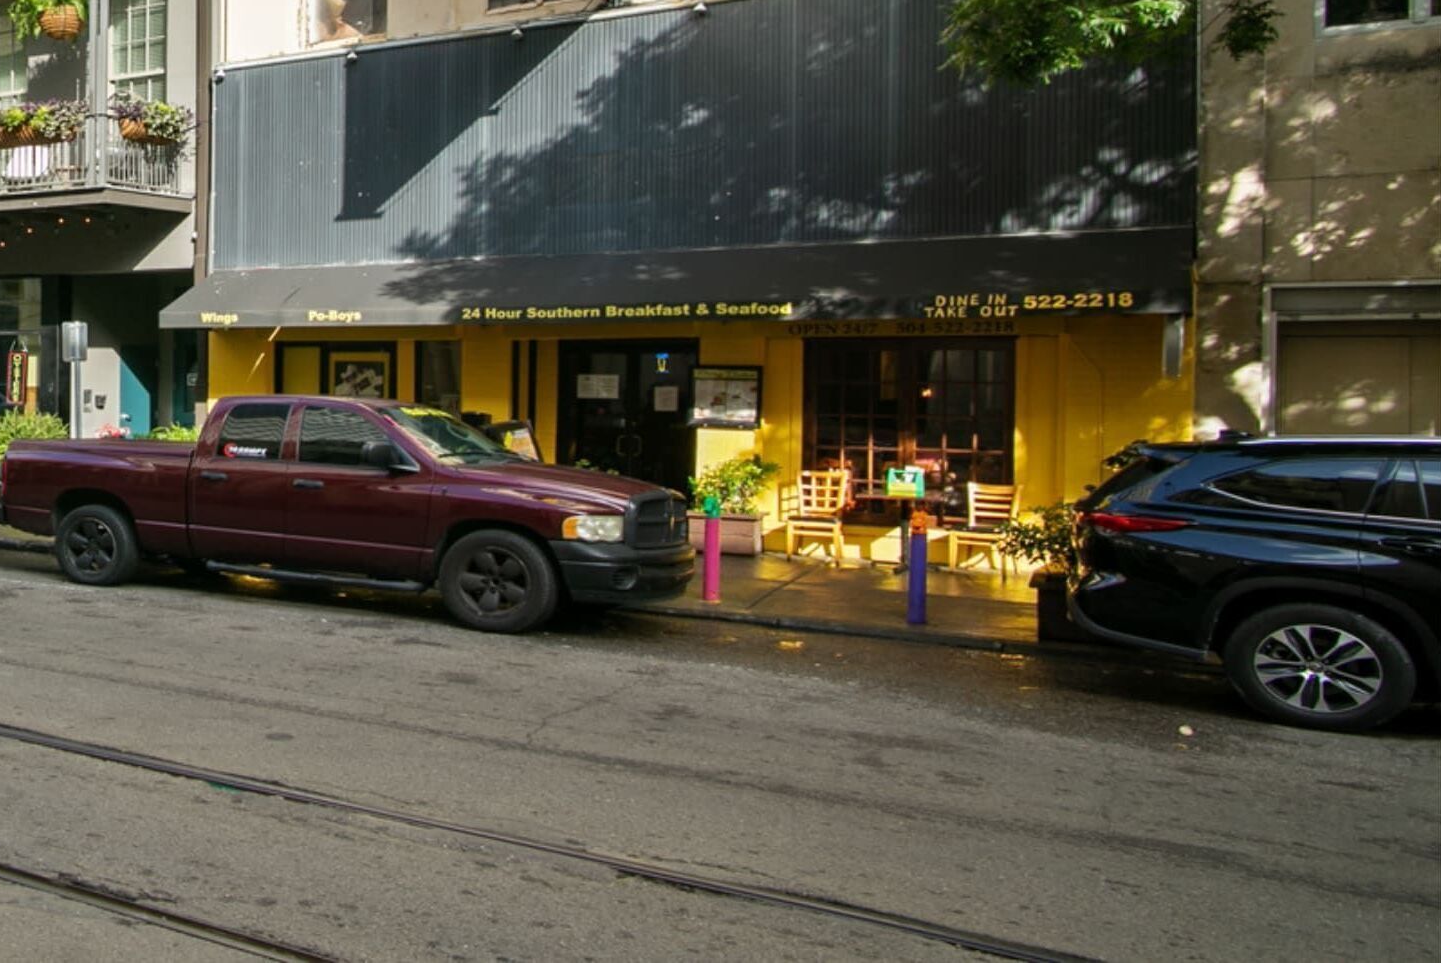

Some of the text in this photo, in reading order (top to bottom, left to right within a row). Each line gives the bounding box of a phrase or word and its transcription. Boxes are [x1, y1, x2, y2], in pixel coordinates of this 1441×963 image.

[935, 293, 1008, 307] DINE IN
[1024, 292, 1134, 309] 522-2218
[308, 310, 362, 324] Po-Boys
[462, 302, 794, 319] 24 Hour Southern Breakfast & Seafood
[924, 305, 1020, 319] TAKE OUT
[200, 312, 239, 325] Wings
[789, 323, 838, 335] OPEN
